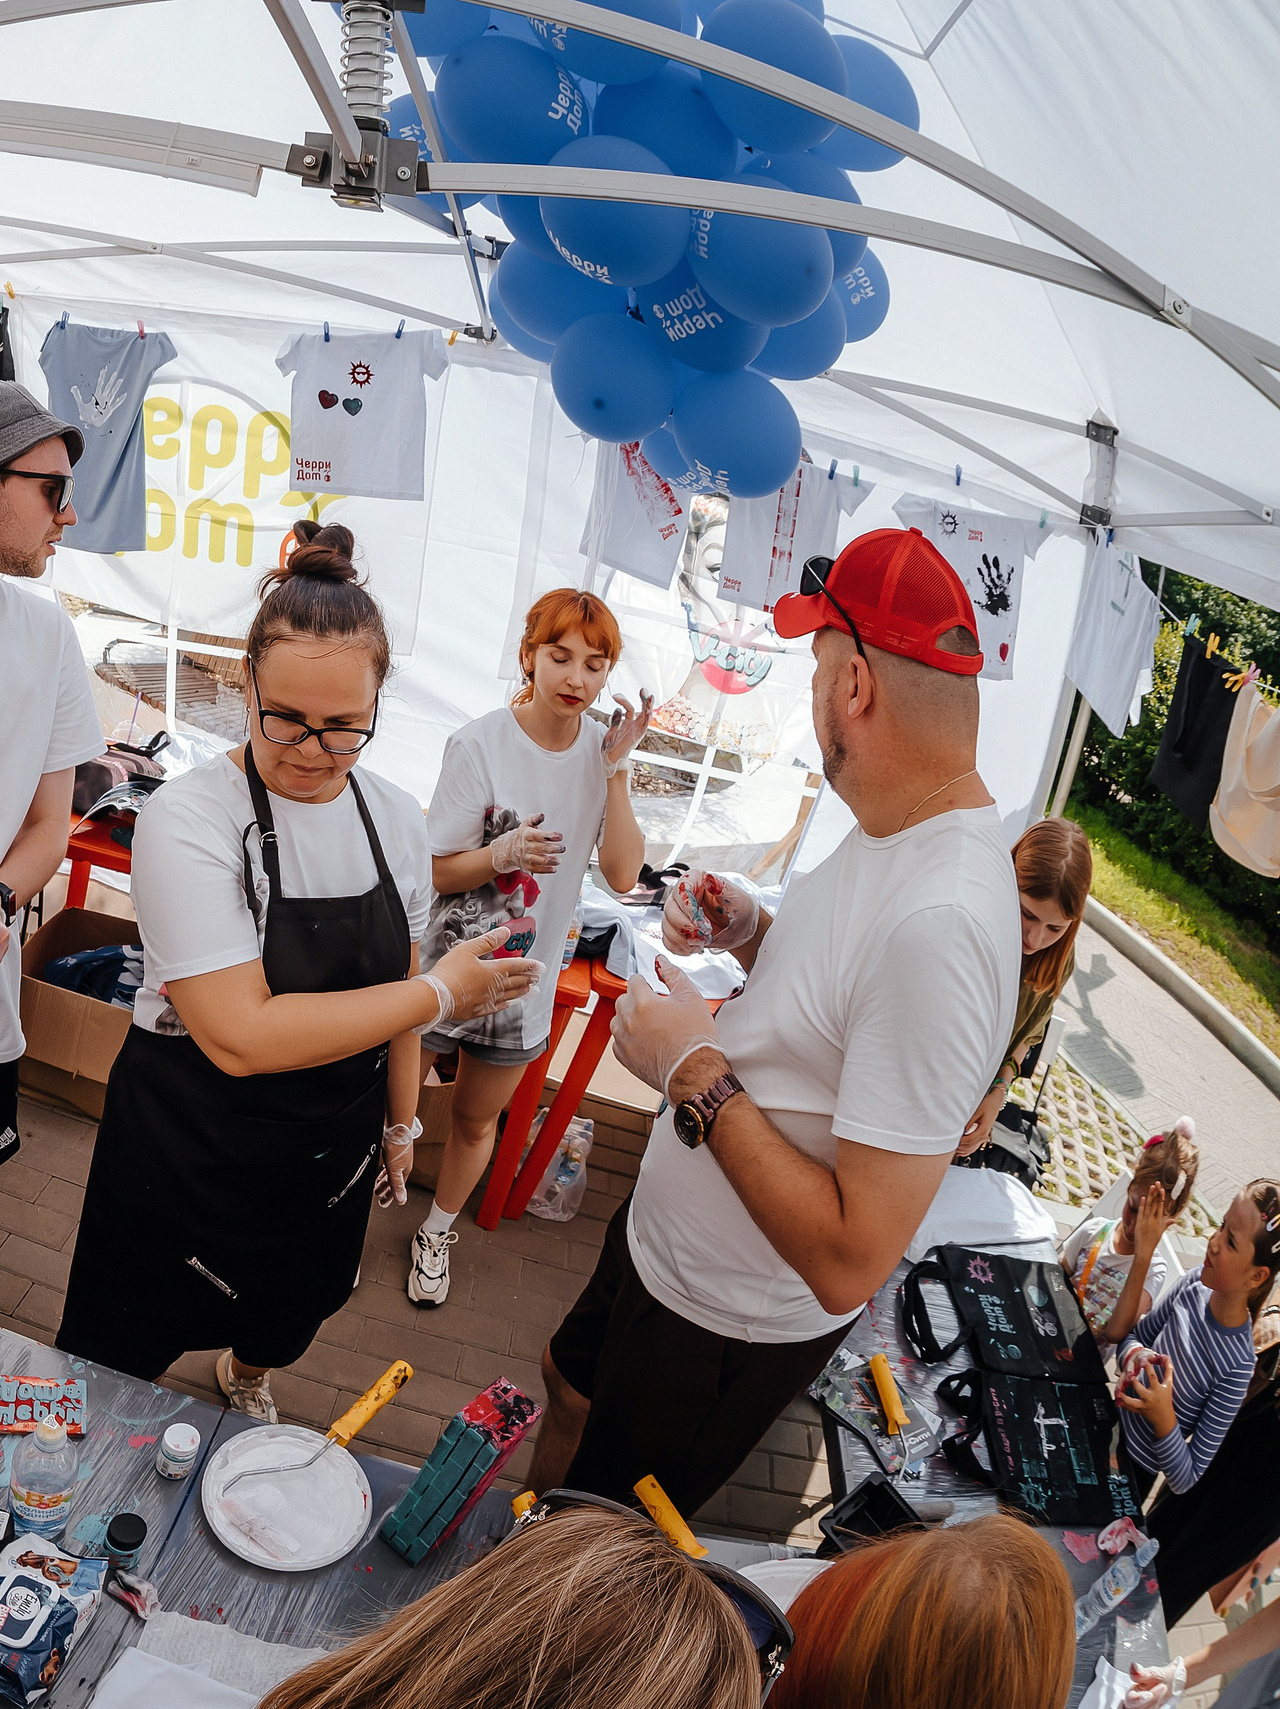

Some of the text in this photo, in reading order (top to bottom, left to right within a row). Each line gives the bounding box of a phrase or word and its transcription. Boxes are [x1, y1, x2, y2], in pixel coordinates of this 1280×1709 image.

[665, 310, 724, 343] Черри
[143, 396, 291, 499] ерр
[295, 457, 331, 472] Черри
[145, 488, 255, 568] ом
